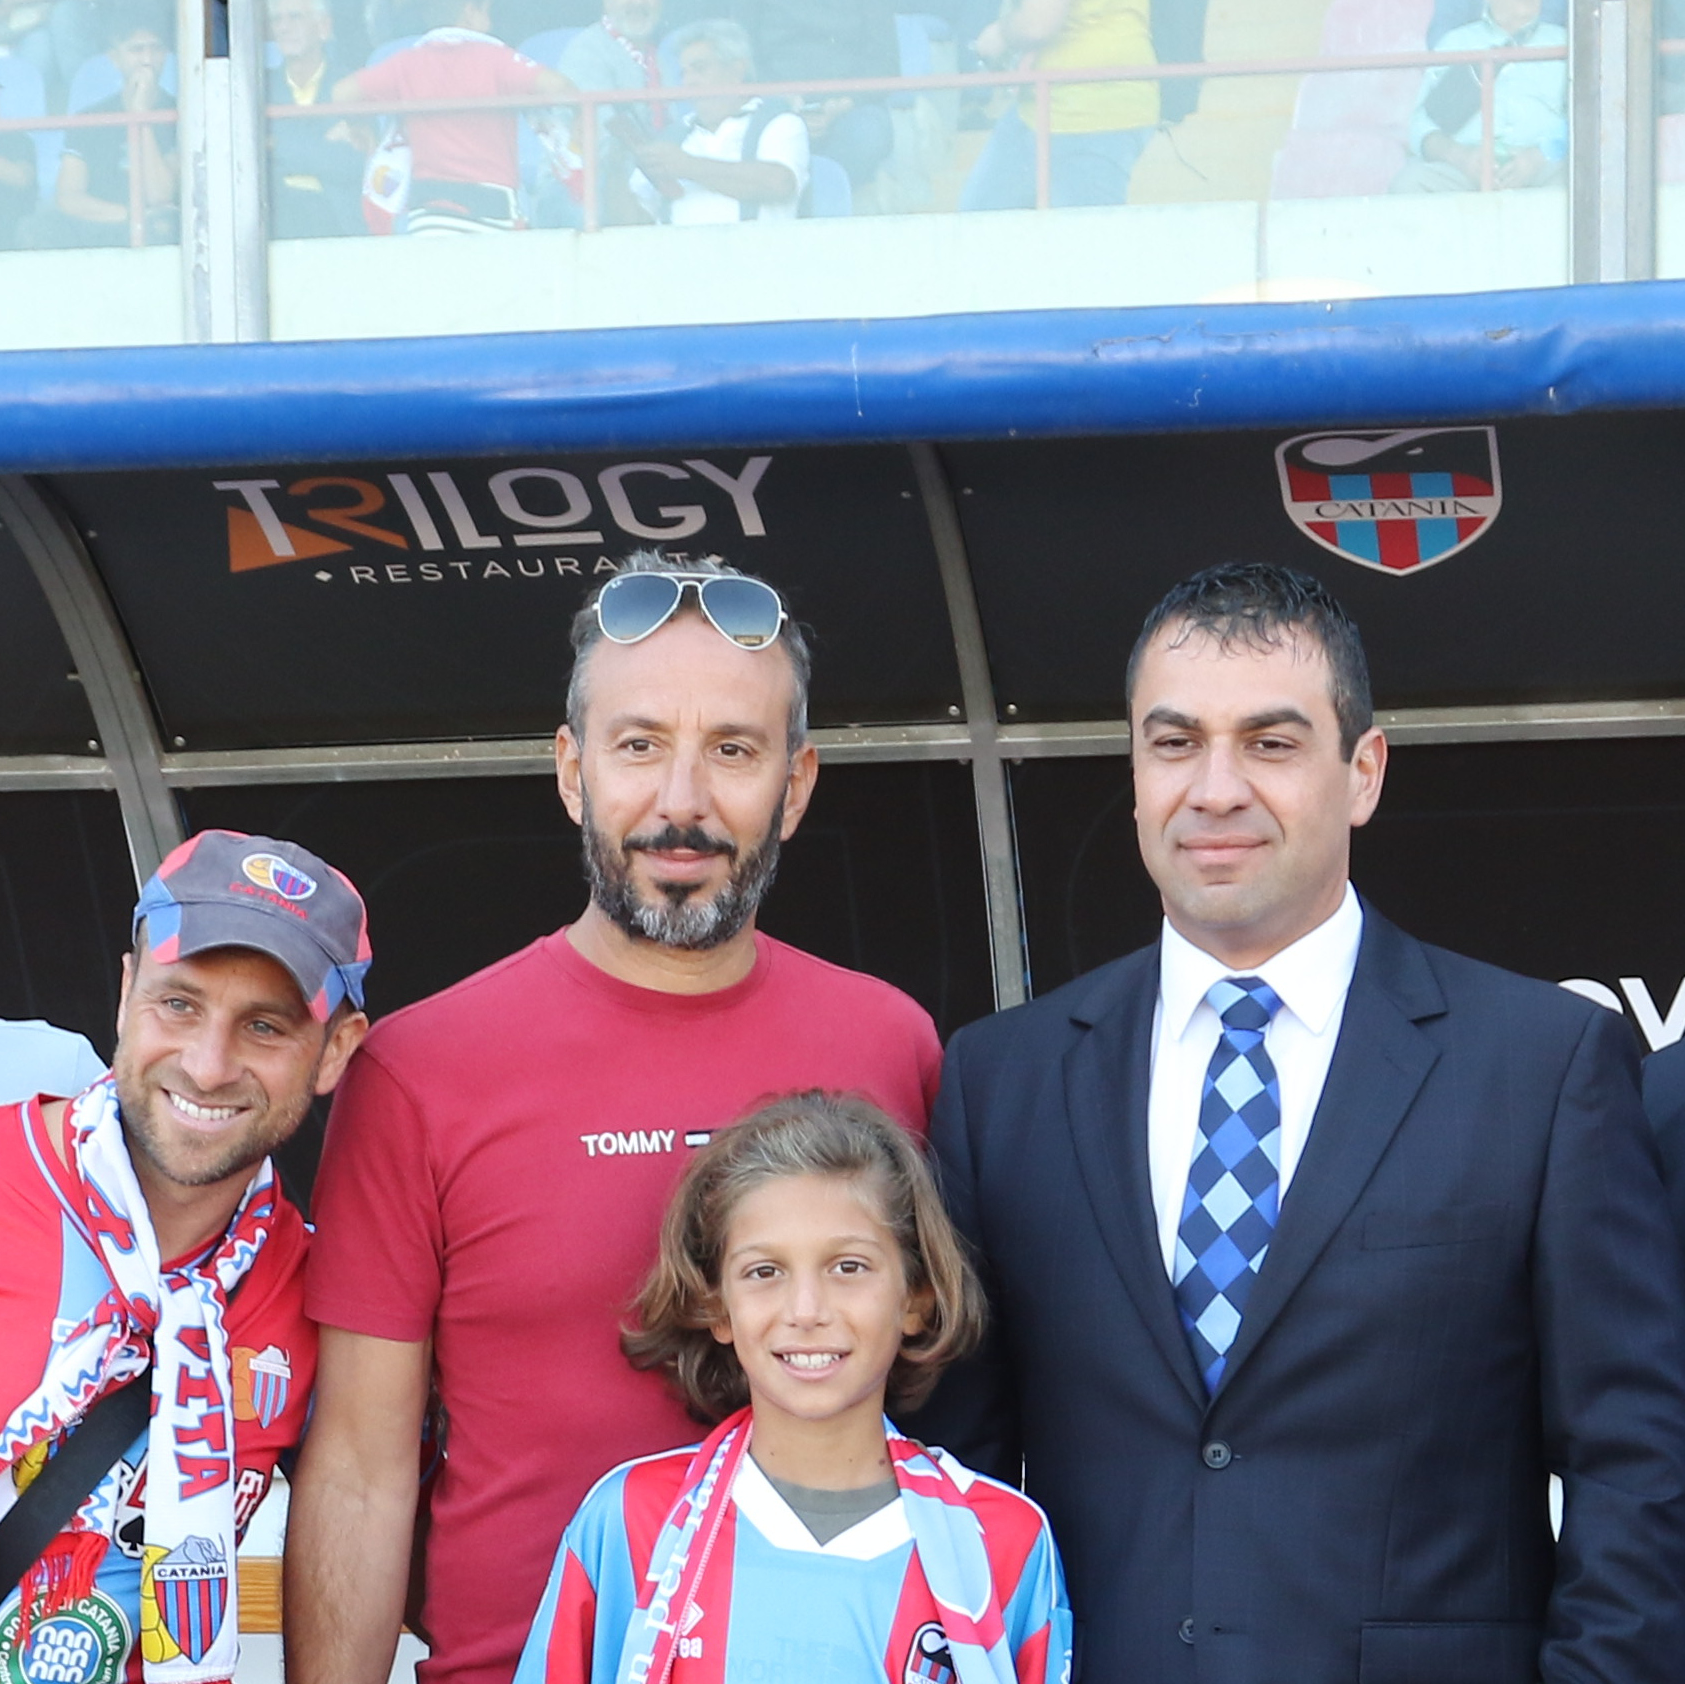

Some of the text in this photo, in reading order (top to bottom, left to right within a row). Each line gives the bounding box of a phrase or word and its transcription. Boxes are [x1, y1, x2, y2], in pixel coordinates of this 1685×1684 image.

[212, 455, 774, 558] TRILOGY
[1315, 499, 1481, 519] CATANIA
[229, 881, 309, 921] CATANIA
[579, 1128, 676, 1157] TOMMY
[156, 1564, 226, 1580] CATANIA
[644, 1550, 690, 1639] per
[77, 1598, 121, 1655] CATANIA
